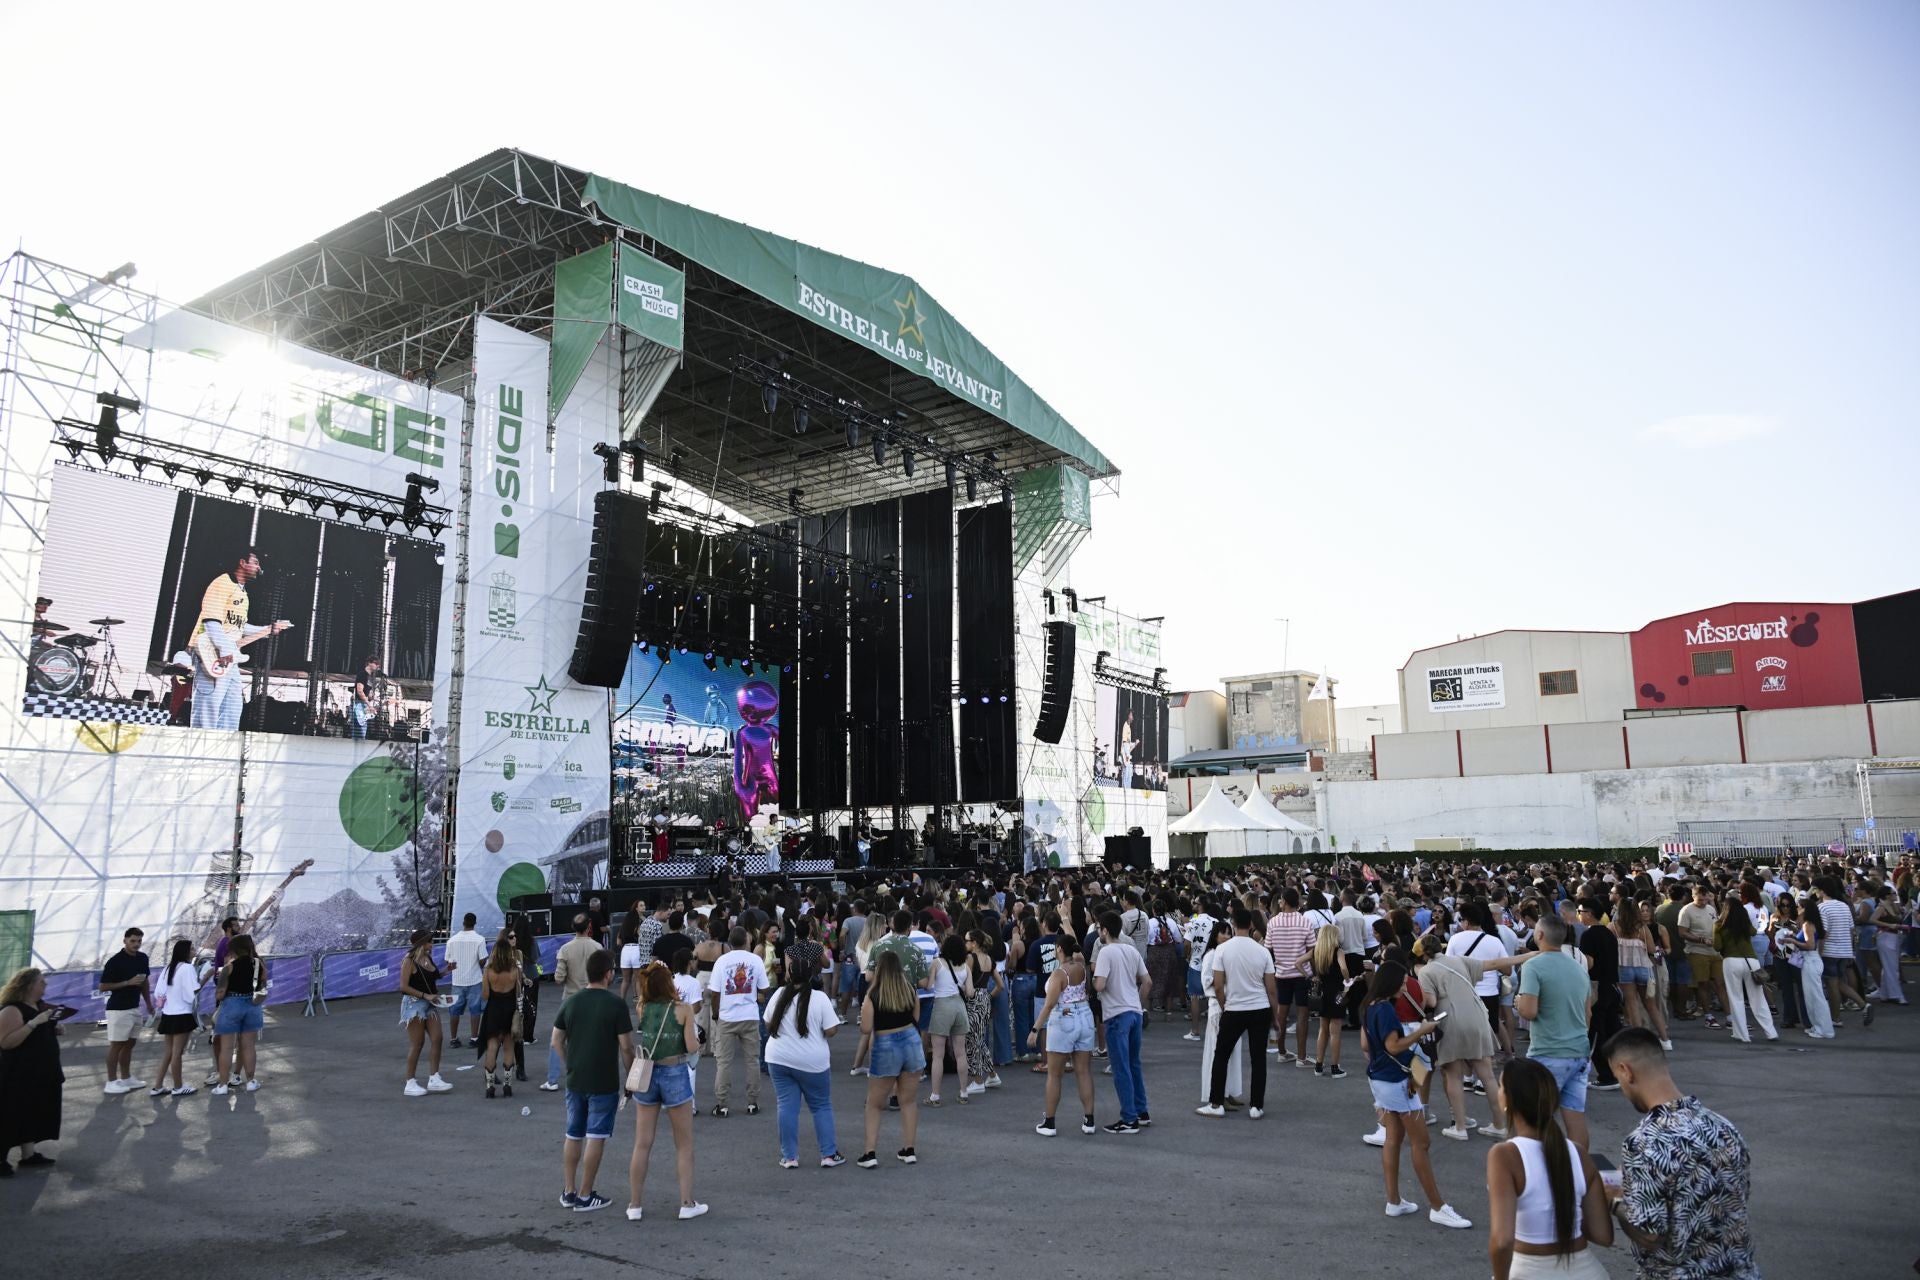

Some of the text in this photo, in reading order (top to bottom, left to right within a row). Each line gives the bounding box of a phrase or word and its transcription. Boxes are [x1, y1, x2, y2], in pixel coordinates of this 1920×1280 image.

[626, 279, 661, 297] CRASH
[645, 299, 674, 316] MUSIC
[799, 282, 1003, 410] ESTRELLA DE LEVANTE
[480, 630, 499, 638] Molina
[507, 634, 525, 642] Segura
[1684, 616, 1789, 645] MESEGUER
[1429, 669, 1462, 677] MARECAR
[1476, 666, 1500, 674] Trucks
[1757, 657, 1786, 669] ARION
[484, 711, 591, 734] ESTRELLA
[511, 730, 569, 741] DE LEVANTE
